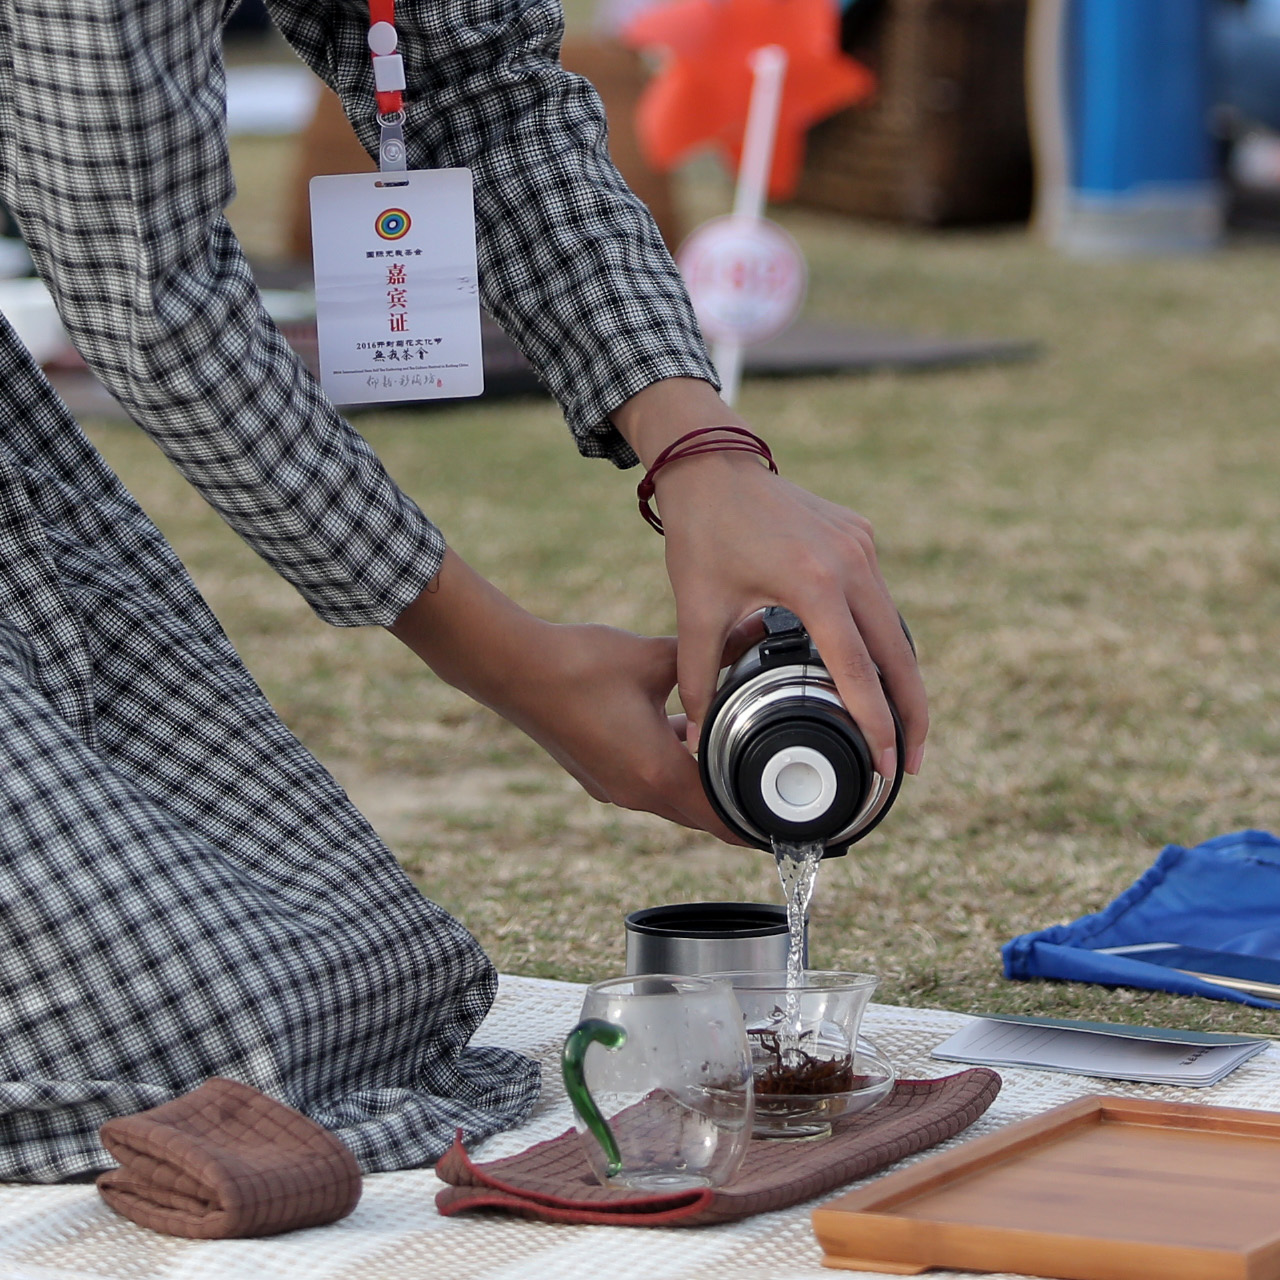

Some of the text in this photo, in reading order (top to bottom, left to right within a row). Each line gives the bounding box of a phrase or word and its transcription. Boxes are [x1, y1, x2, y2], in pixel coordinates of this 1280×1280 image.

[366, 248, 423, 258] 国际无我茶会
[386, 263, 409, 332] 嘉宾证
